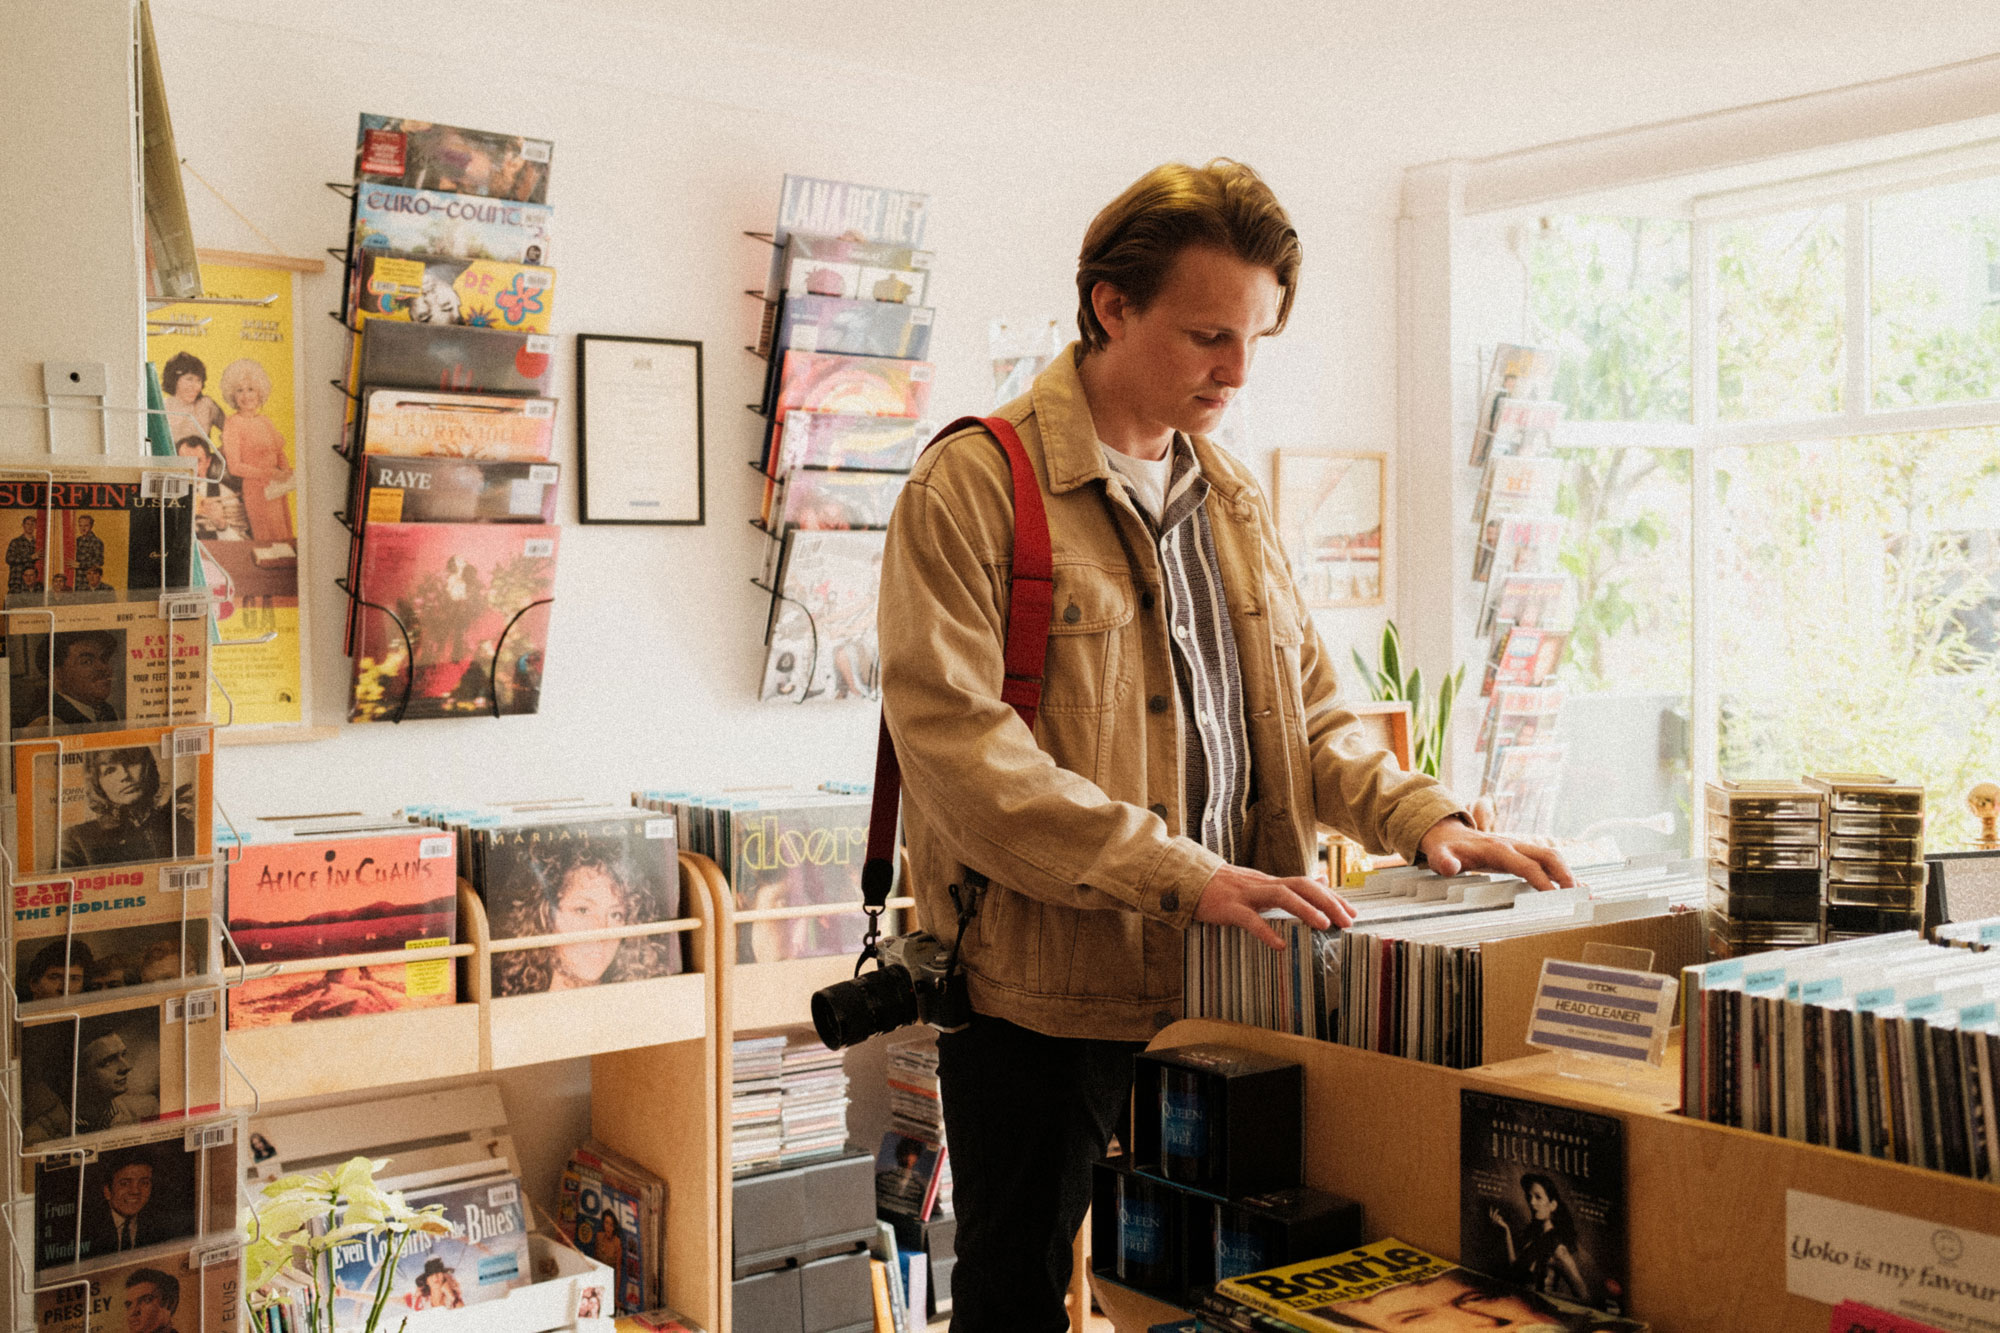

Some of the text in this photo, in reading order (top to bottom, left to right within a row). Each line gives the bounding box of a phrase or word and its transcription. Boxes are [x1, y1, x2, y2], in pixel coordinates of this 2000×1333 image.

[379, 468, 431, 489] RAYE
[0, 482, 137, 508] SURFIN'
[133, 497, 186, 509] U.S.A.
[50, 795, 85, 805] WLKER
[491, 829, 588, 846] MARIAH
[37, 871, 144, 896] swinging
[256, 865, 319, 894] ALICE
[15, 890, 83, 909] scene
[15, 896, 147, 921] THE PEDDLERS
[1594, 983, 1617, 993] TDK
[1555, 1000, 1641, 1023] HEAD CLEANER
[1161, 1100, 1202, 1121] QUEEN
[44, 1202, 76, 1219] From
[1118, 1207, 1160, 1228] QUEEN
[44, 1228, 53, 1238] a
[334, 1243, 366, 1270] Even
[463, 1203, 516, 1246] Blues
[44, 1238, 91, 1260] Windw
[1219, 1239, 1261, 1261] QUEEN
[1790, 1235, 1849, 1266] Yoko
[1854, 1251, 1872, 1270] is
[1877, 1260, 1916, 1287] my
[56, 1281, 101, 1304] ELVS
[222, 1280, 238, 1323] ELVIS
[1281, 1297, 1311, 1310] In
[1312, 1289, 1343, 1305] His
[1344, 1278, 1386, 1298] Own
[43, 1296, 112, 1325] PRESEY
